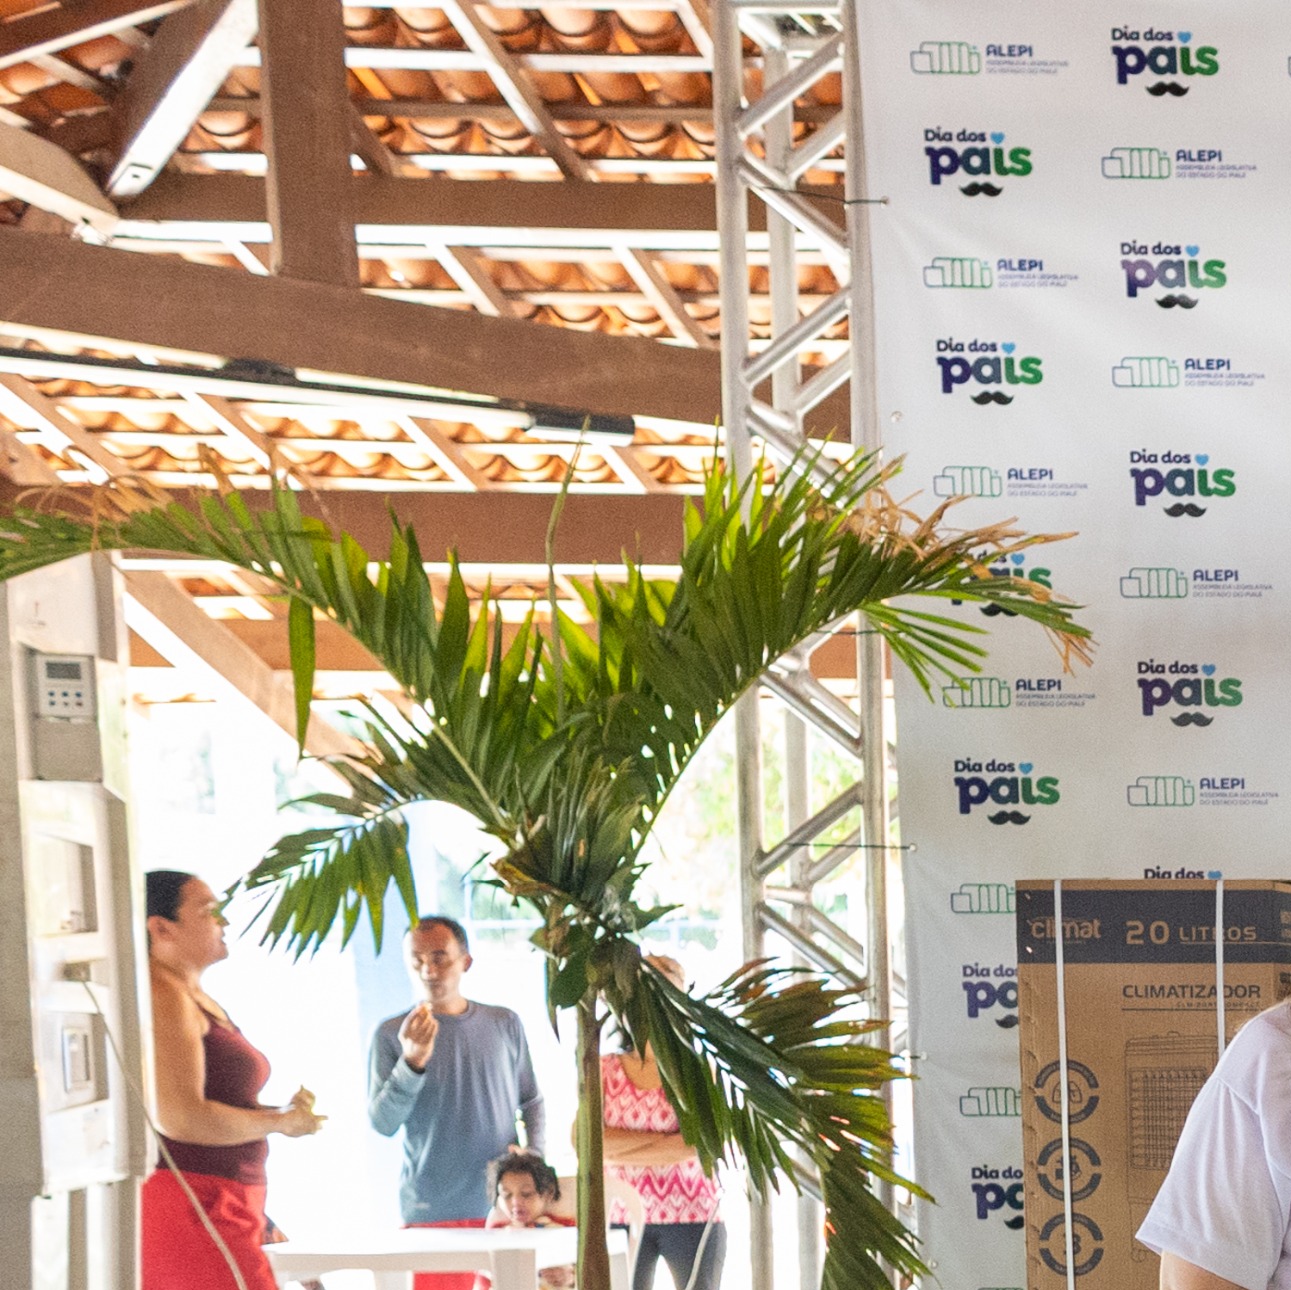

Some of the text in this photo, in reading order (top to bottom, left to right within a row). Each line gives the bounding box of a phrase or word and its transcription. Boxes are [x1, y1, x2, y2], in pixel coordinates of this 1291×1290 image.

[1111, 25, 1174, 41] Dia dos
[986, 44, 1033, 57] ALEPI
[1111, 45, 1219, 85] pais
[924, 126, 987, 142] Dia dos
[1176, 150, 1222, 162] ALEPI
[924, 146, 1033, 185] pais
[1120, 240, 1182, 256] Dia dos
[998, 259, 1043, 271] ALEPI
[1121, 259, 1227, 298] pais
[936, 337, 997, 352] Dia dos
[1185, 359, 1230, 370] ALEPI
[936, 356, 1043, 394] pais
[1130, 448, 1191, 464] Dia dos
[1008, 468, 1053, 480] ALEPI
[1129, 468, 1236, 506] pais
[1193, 570, 1238, 581] ALEPI
[1137, 659, 1198, 674] Dia dos
[1016, 679, 1061, 691] ALEPI
[1137, 678, 1243, 716] pais
[954, 757, 1015, 773] Dia dos
[1200, 778, 1244, 789] ALEPI
[954, 776, 1060, 815] pais
[1144, 865, 1204, 879] Dia dos
[1125, 920, 1170, 945] 20
[963, 962, 990, 977] Dia
[962, 981, 1018, 1018] pa
[971, 1164, 1023, 1179] Dia do
